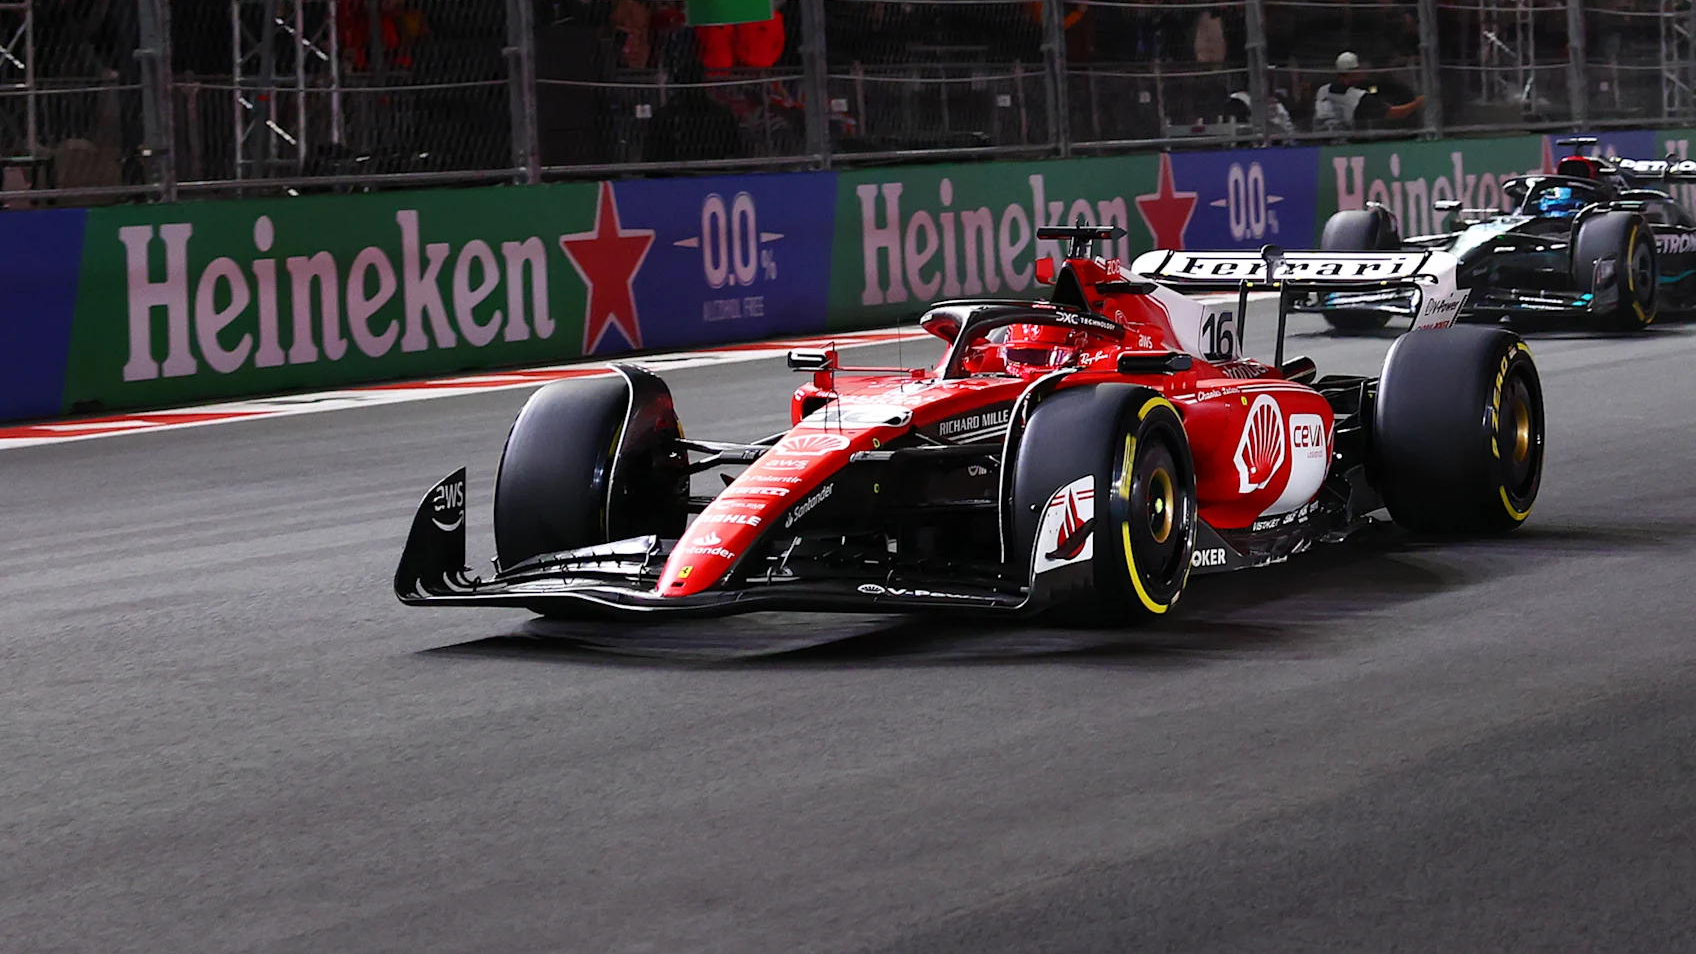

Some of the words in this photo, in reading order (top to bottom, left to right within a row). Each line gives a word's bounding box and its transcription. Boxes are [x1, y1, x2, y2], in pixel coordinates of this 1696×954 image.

[118, 209, 556, 383] Heineken
[1202, 311, 1234, 361] 16
[939, 415, 980, 437] RICHARD
[981, 409, 1010, 427] MILLE
[793, 482, 835, 523] Santander
[1191, 547, 1227, 567] OKER
